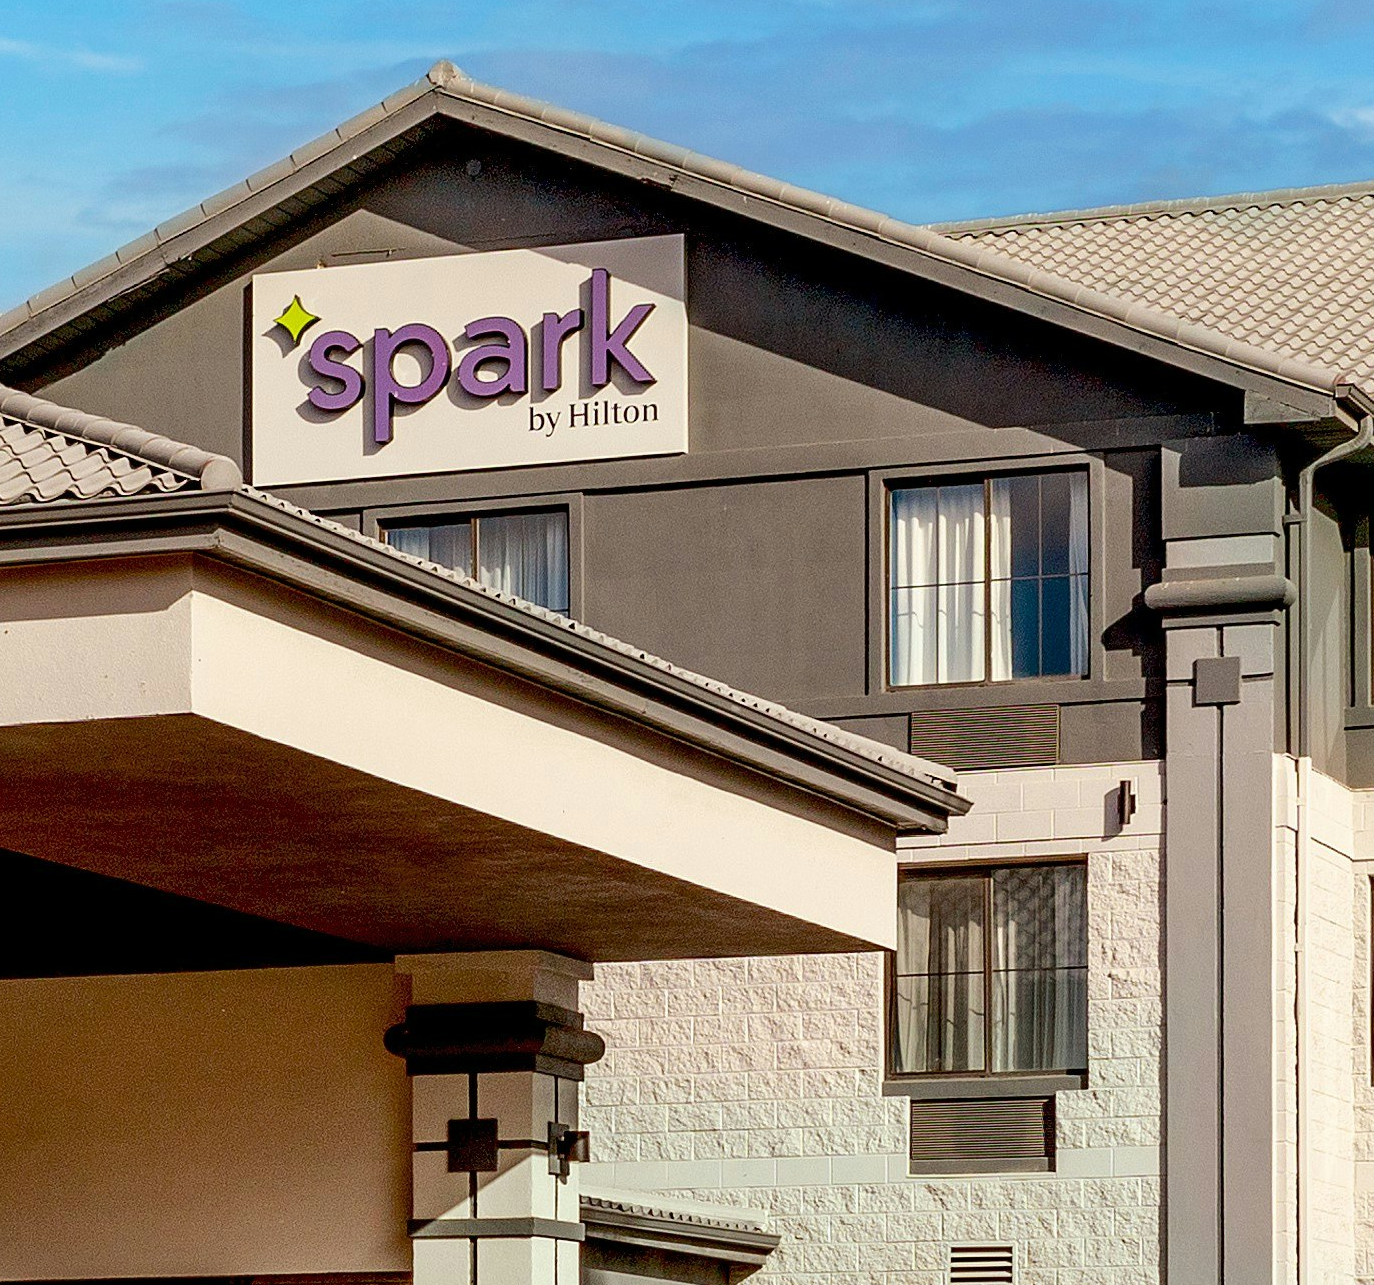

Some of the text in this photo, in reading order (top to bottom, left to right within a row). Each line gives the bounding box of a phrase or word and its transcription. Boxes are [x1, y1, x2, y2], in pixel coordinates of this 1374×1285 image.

[307, 267, 658, 445] spark
[528, 400, 660, 437] by Hilton
